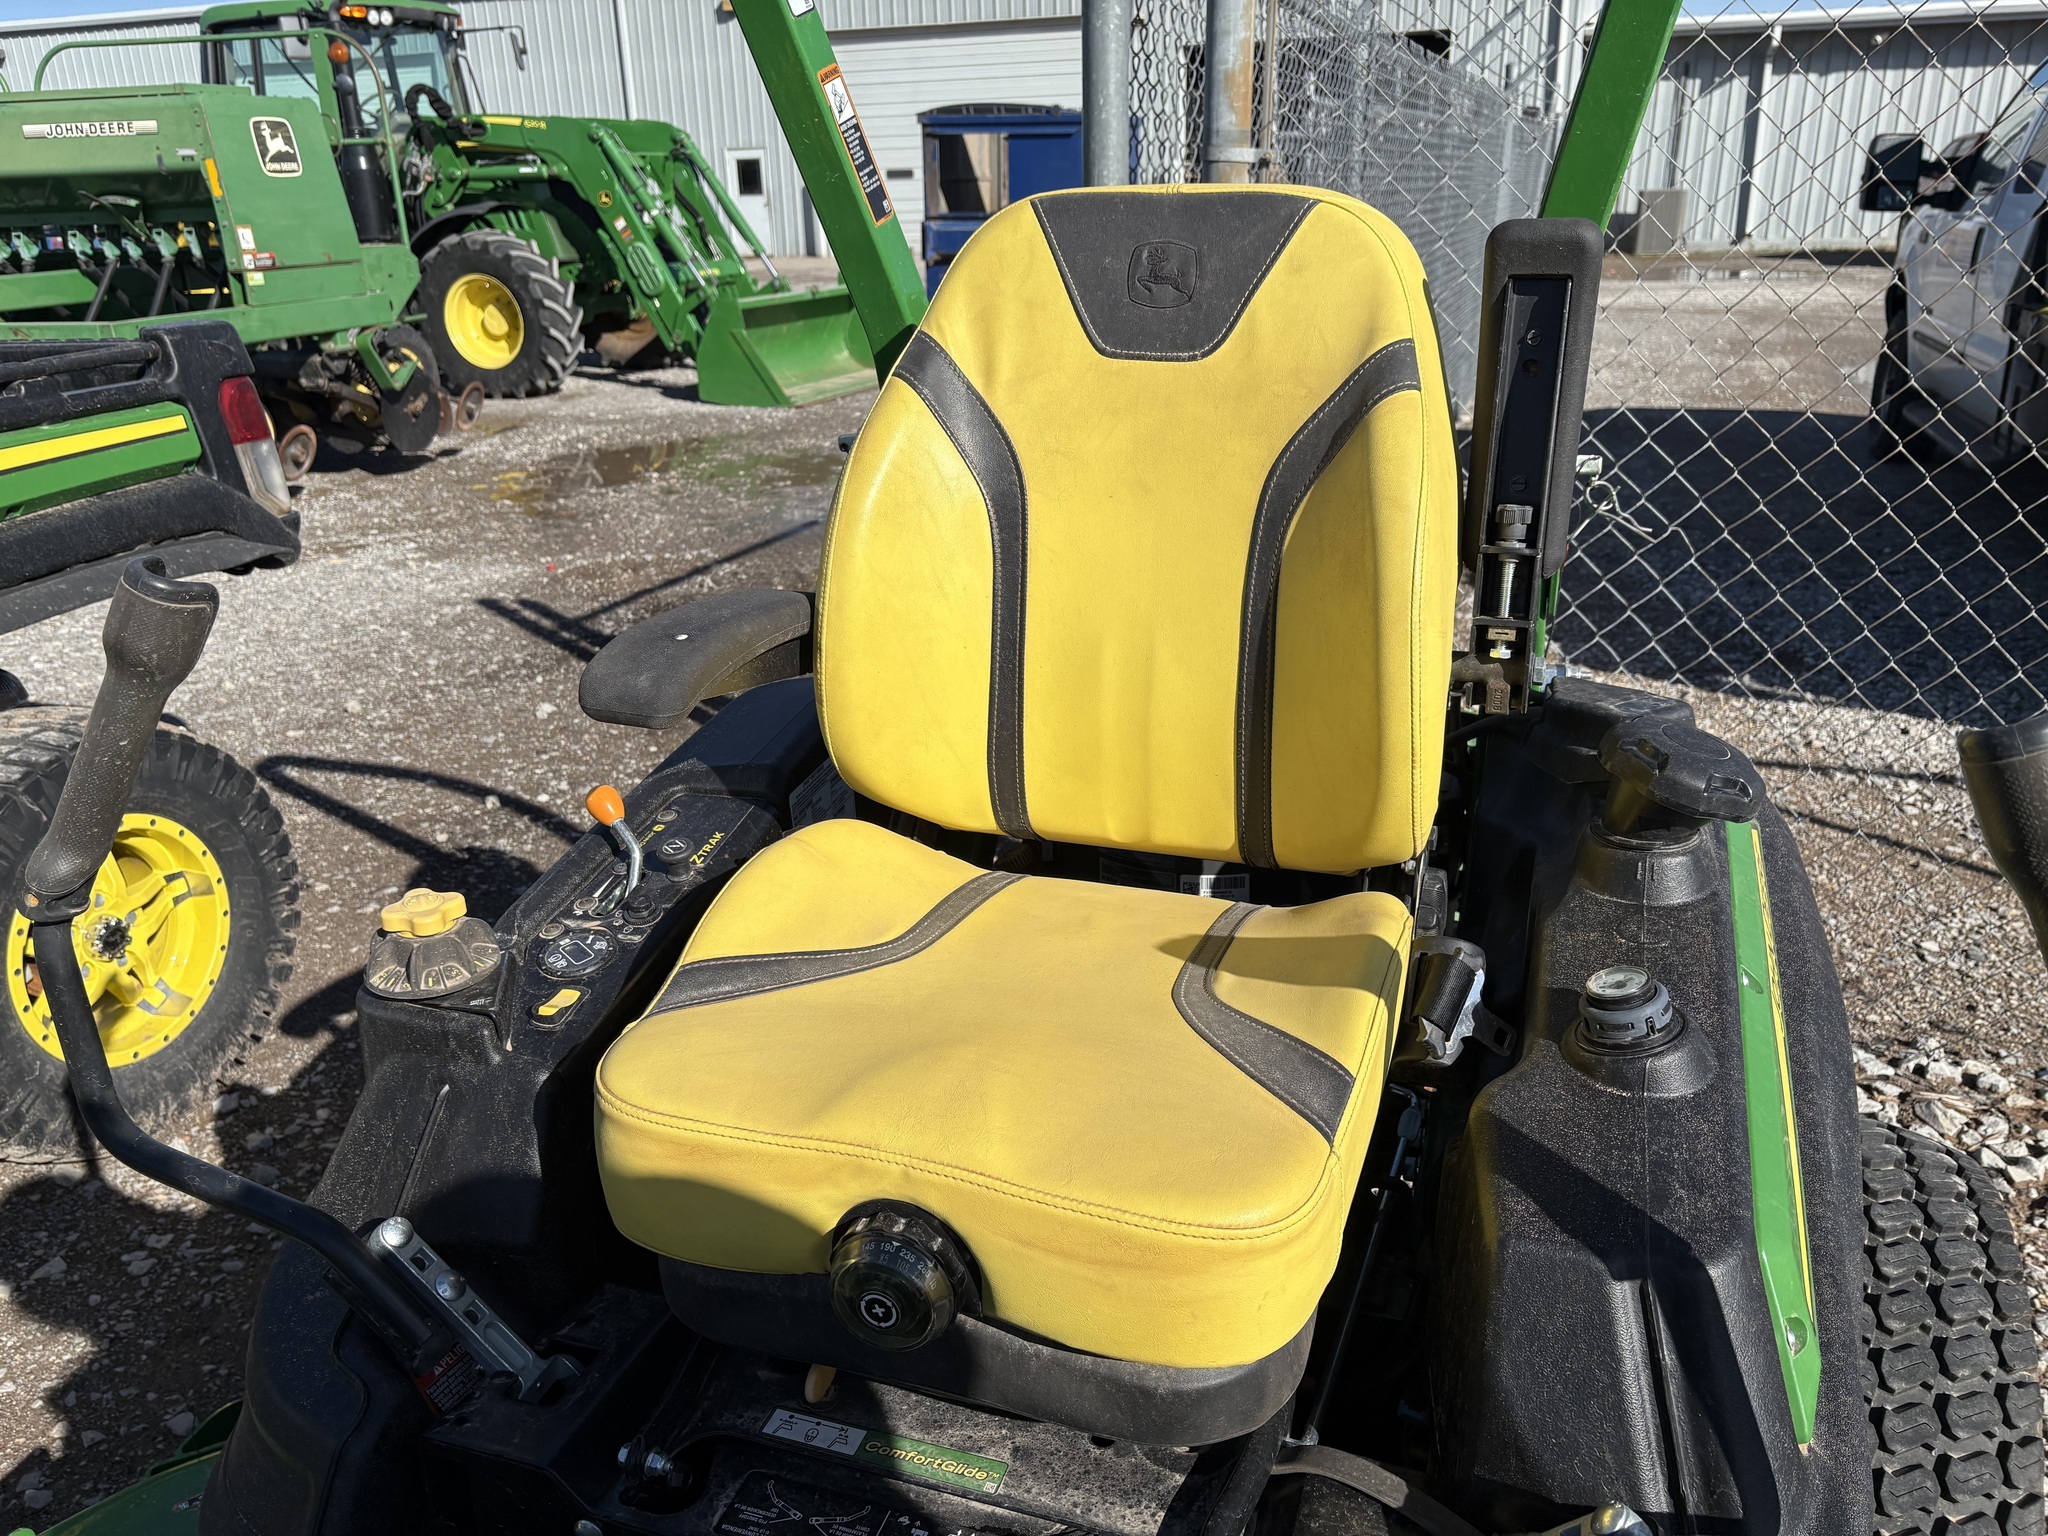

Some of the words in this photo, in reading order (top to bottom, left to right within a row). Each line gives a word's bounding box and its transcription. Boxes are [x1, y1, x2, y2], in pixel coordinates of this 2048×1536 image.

[46, 123, 84, 137] JOHN
[88, 121, 135, 135] DEERE
[266, 161, 281, 172] JOHN
[281, 161, 299, 172] DEERE
[690, 831, 725, 864] ZTRAK
[880, 1242, 896, 1253] 190
[899, 1248, 917, 1263] 235
[917, 1261, 932, 1278] 280
[895, 1259, 911, 1273] 105
[440, 1344, 466, 1369] PELIG
